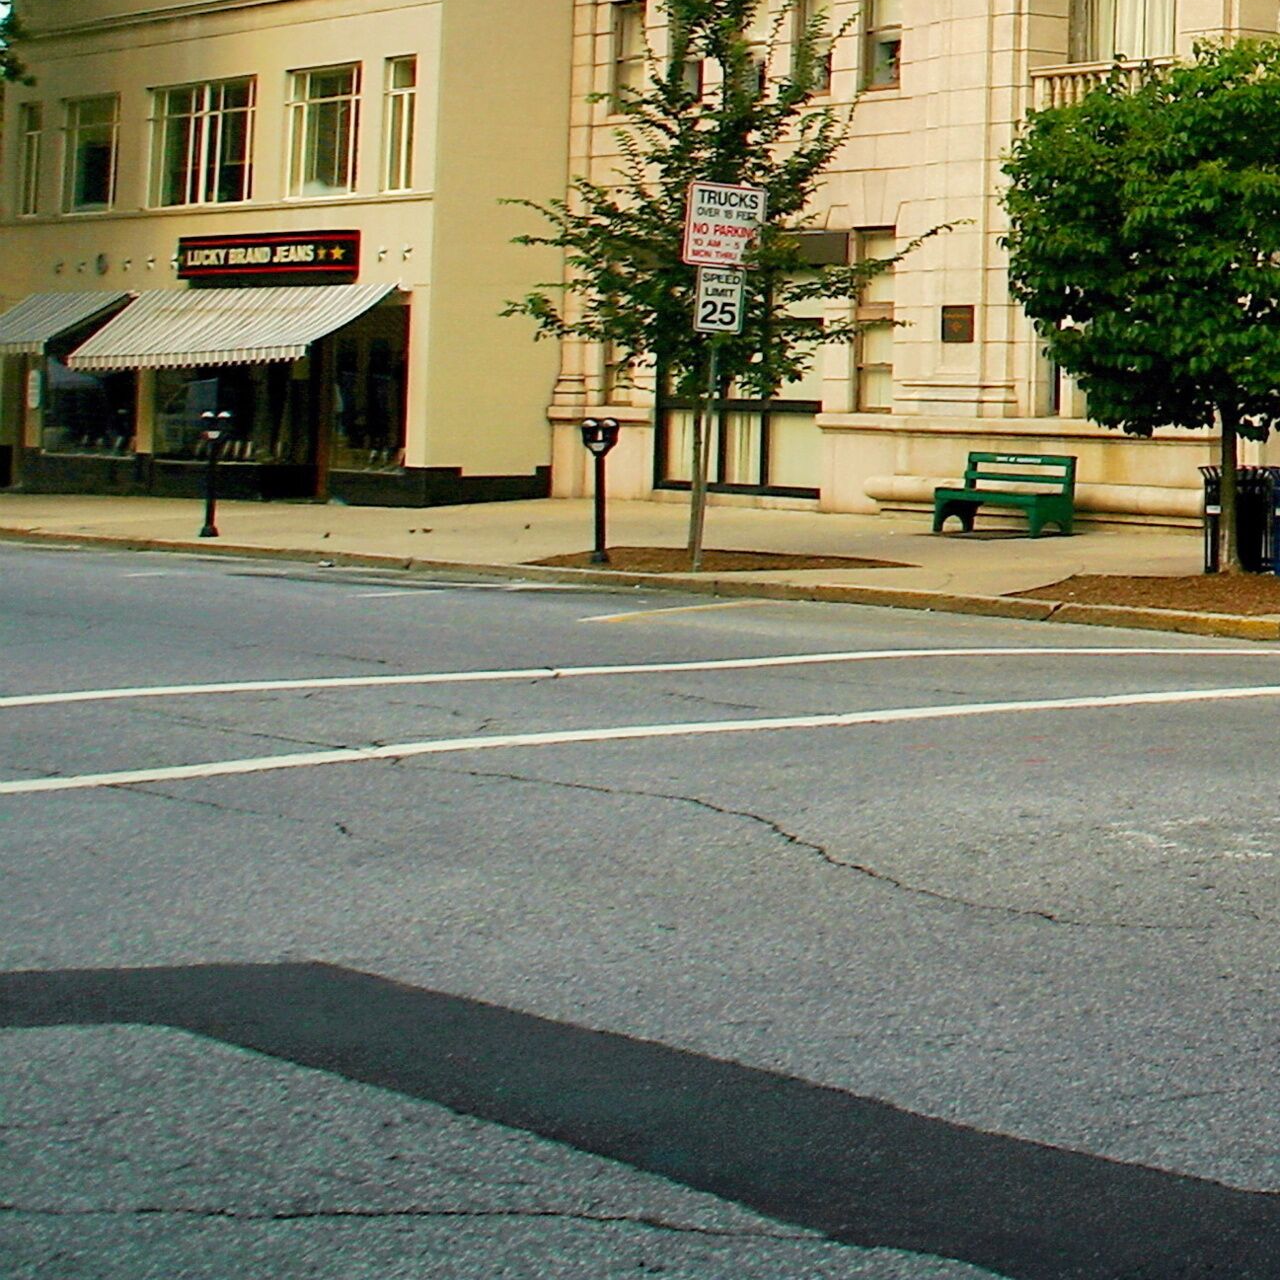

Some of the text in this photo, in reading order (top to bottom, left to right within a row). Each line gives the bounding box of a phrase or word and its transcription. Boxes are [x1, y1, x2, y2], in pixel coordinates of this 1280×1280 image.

[698, 188, 759, 210] TRUCKS
[697, 206, 720, 218] OVER
[693, 222, 758, 240] NO PARKING
[186, 244, 315, 266] LUCKY BRAND JEANS
[702, 272, 741, 285] SPEED
[705, 287, 736, 297] LIMIT
[700, 300, 736, 326] 25
